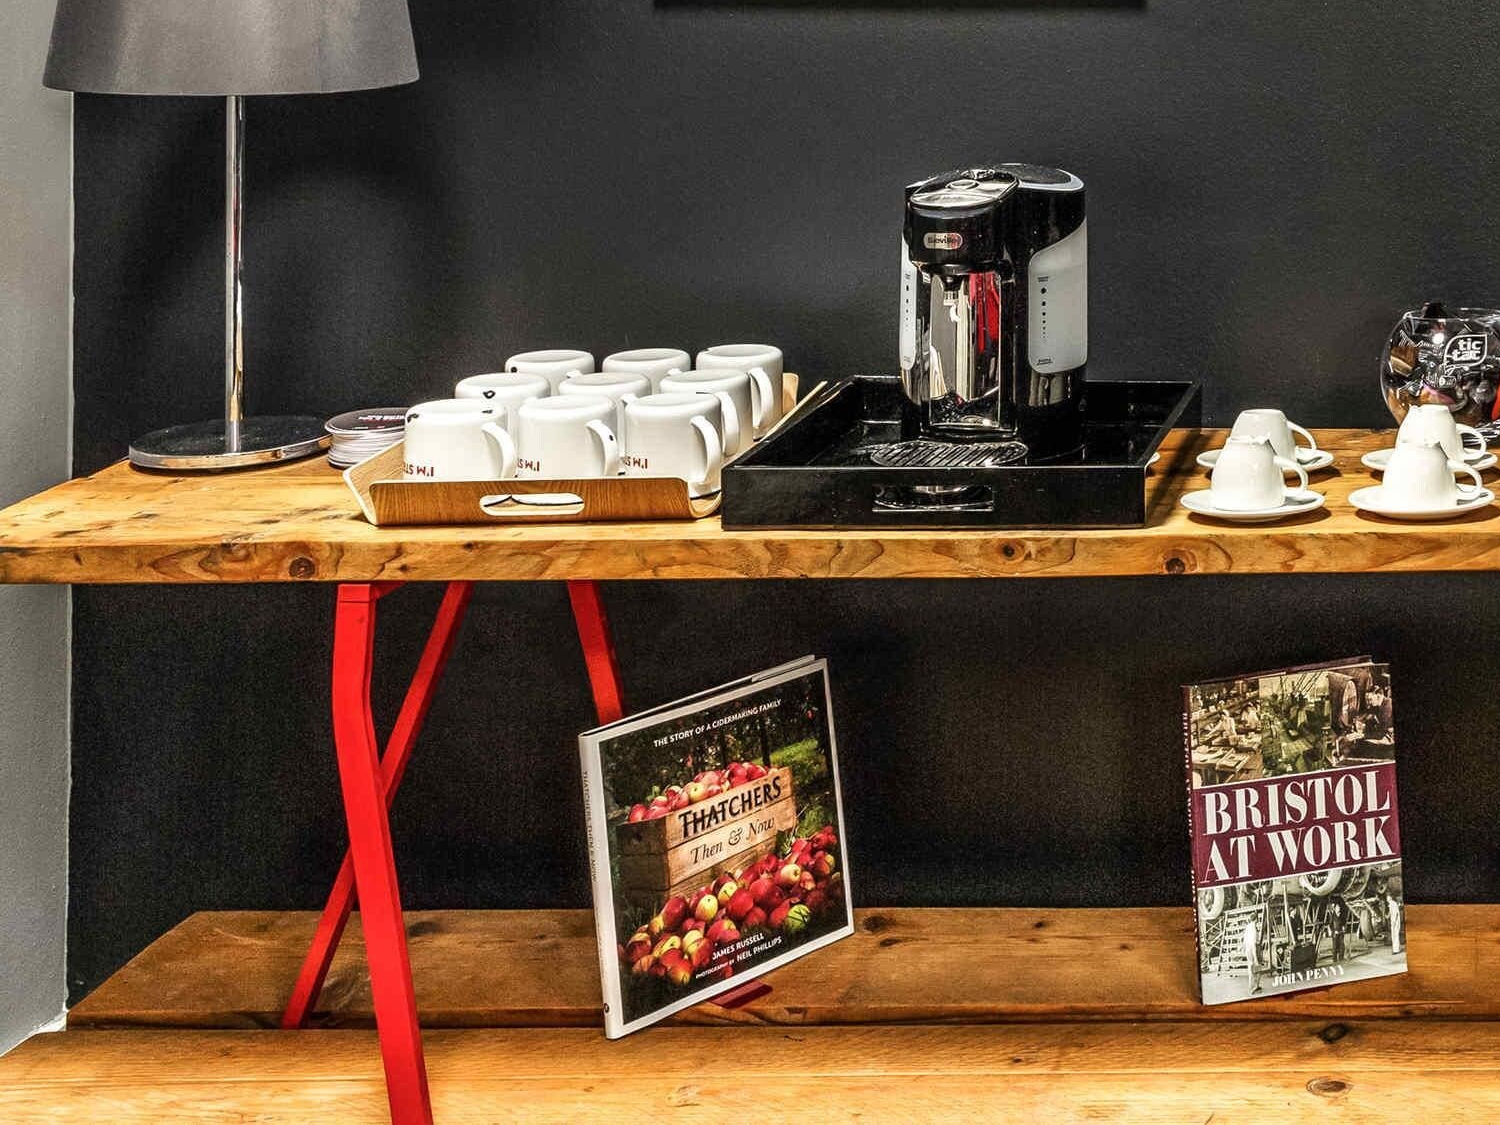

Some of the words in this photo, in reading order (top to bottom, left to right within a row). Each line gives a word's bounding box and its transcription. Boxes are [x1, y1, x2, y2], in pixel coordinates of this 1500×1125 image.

[1452, 349, 1481, 361] tac
[1458, 338, 1483, 350] tic
[417, 465, 434, 477] I'M
[525, 460, 540, 472] I'M
[633, 458, 648, 469] I'M
[653, 739, 668, 747] THE
[670, 730, 694, 743] STORY
[695, 726, 705, 734] OF
[706, 723, 712, 731] A
[712, 706, 758, 728] CIDERMAKING
[759, 699, 782, 714] FAMILY
[678, 776, 782, 838] THATCHERS
[1201, 770, 1391, 836] BRISTOL
[690, 842, 723, 864] Then
[728, 827, 743, 846] &
[746, 817, 775, 840] Now
[1200, 835, 1256, 884] AT
[1264, 815, 1396, 872] WORK
[712, 944, 735, 960] JAMES
[736, 933, 765, 949] RUSSELL
[736, 950, 753, 962] NEIL
[753, 936, 782, 955] PHILLIPS
[1272, 971, 1304, 988] JOHN
[1306, 964, 1344, 981] PENNY
